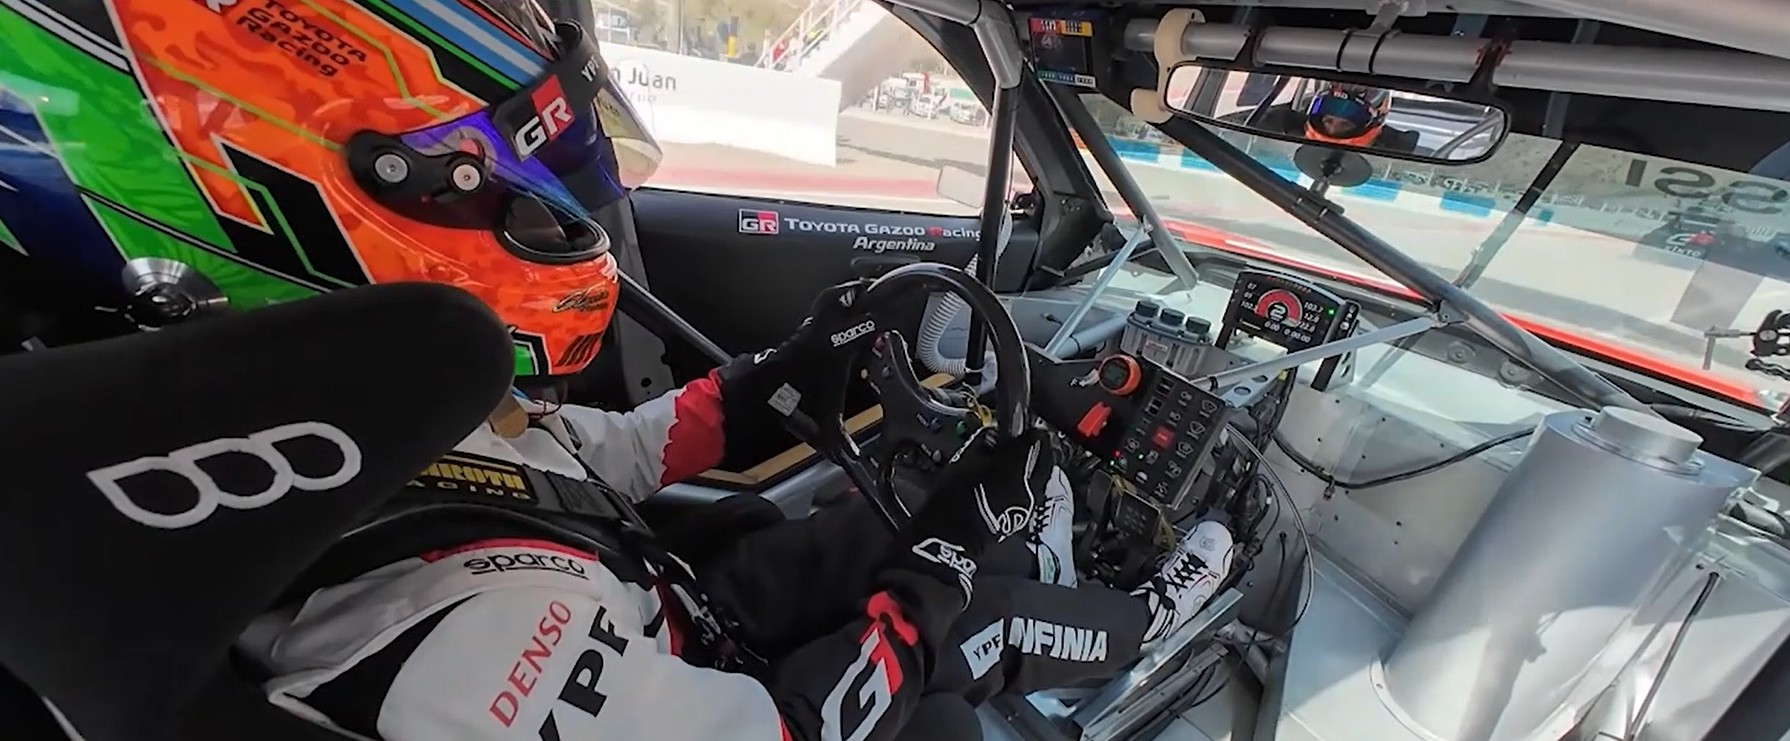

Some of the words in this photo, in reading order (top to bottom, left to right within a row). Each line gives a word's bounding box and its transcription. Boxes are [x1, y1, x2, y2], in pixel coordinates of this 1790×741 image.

[247, 7, 350, 66] GAZOO
[265, 0, 367, 62] TOYOTA
[236, 16, 338, 77] Racing
[628, 67, 677, 91] Juan
[514, 96, 572, 156] GR
[741, 217, 777, 233] GR
[783, 217, 860, 234] TOYOTA
[864, 223, 925, 236] GAZOO
[852, 236, 936, 254] Argentina
[1269, 303, 1286, 320] 2
[831, 320, 876, 347] sparco
[463, 552, 586, 576] sparco
[972, 633, 1002, 662] YPF
[489, 600, 572, 728] DENSO
[538, 605, 630, 741] PF
